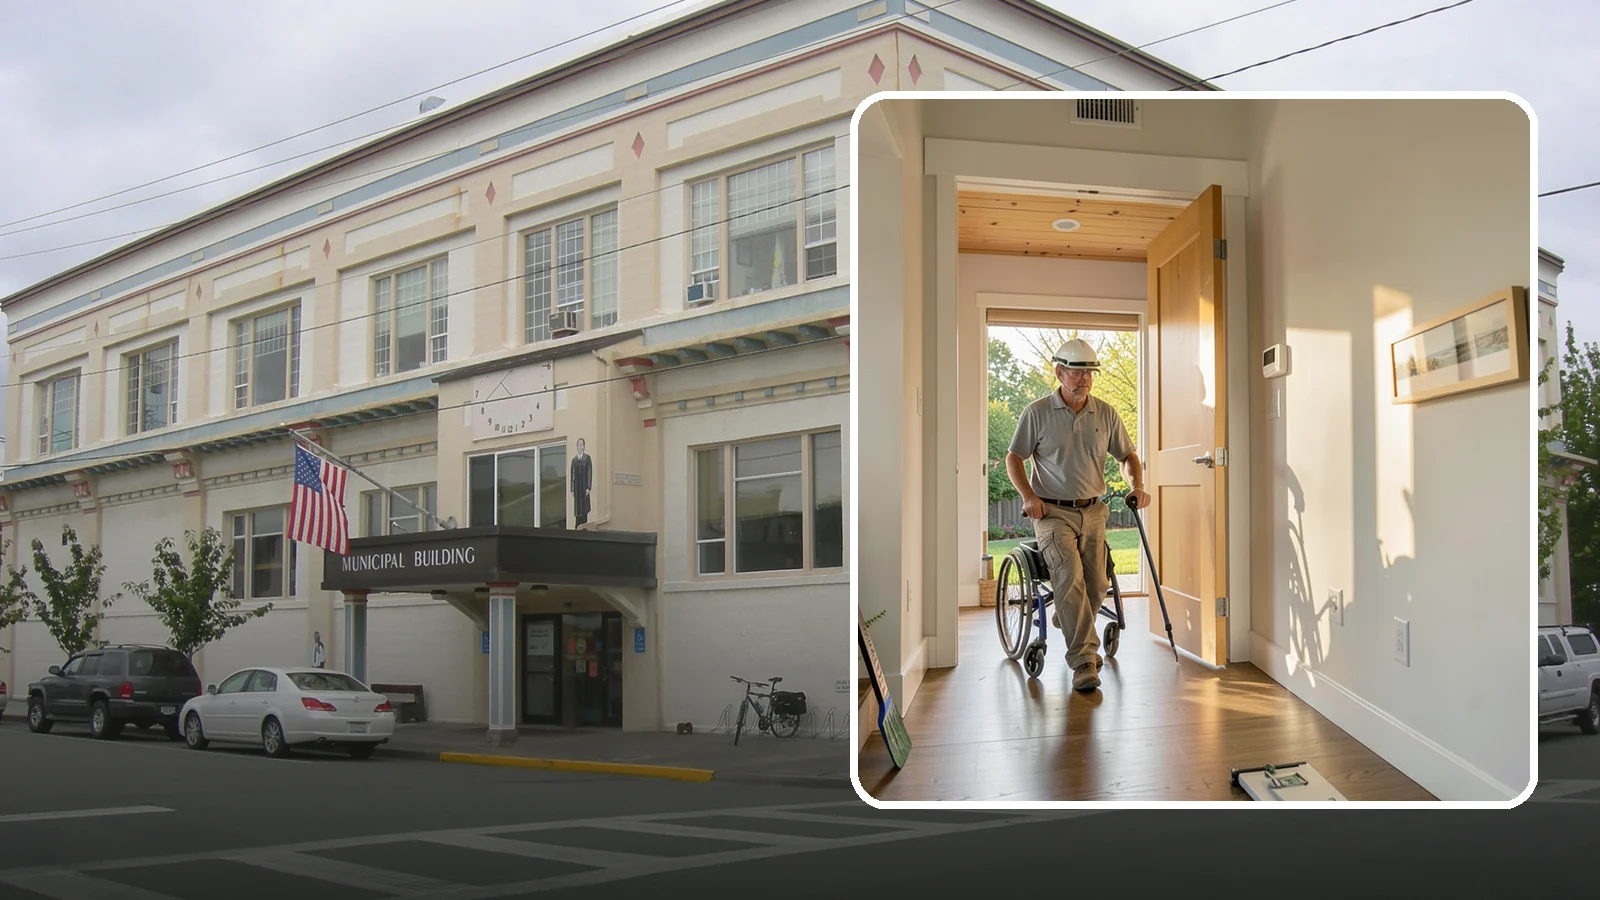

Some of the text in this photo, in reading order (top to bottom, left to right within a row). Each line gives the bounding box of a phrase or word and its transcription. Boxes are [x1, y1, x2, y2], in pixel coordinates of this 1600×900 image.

[480, 406, 485, 415] 8
[487, 417, 492, 426] 9
[494, 423, 500, 432] 10
[507, 425, 514, 433] 12
[521, 420, 526, 428] 2
[528, 413, 533, 422] 3
[342, 546, 475, 572] MUNICIPAL BUILDING
